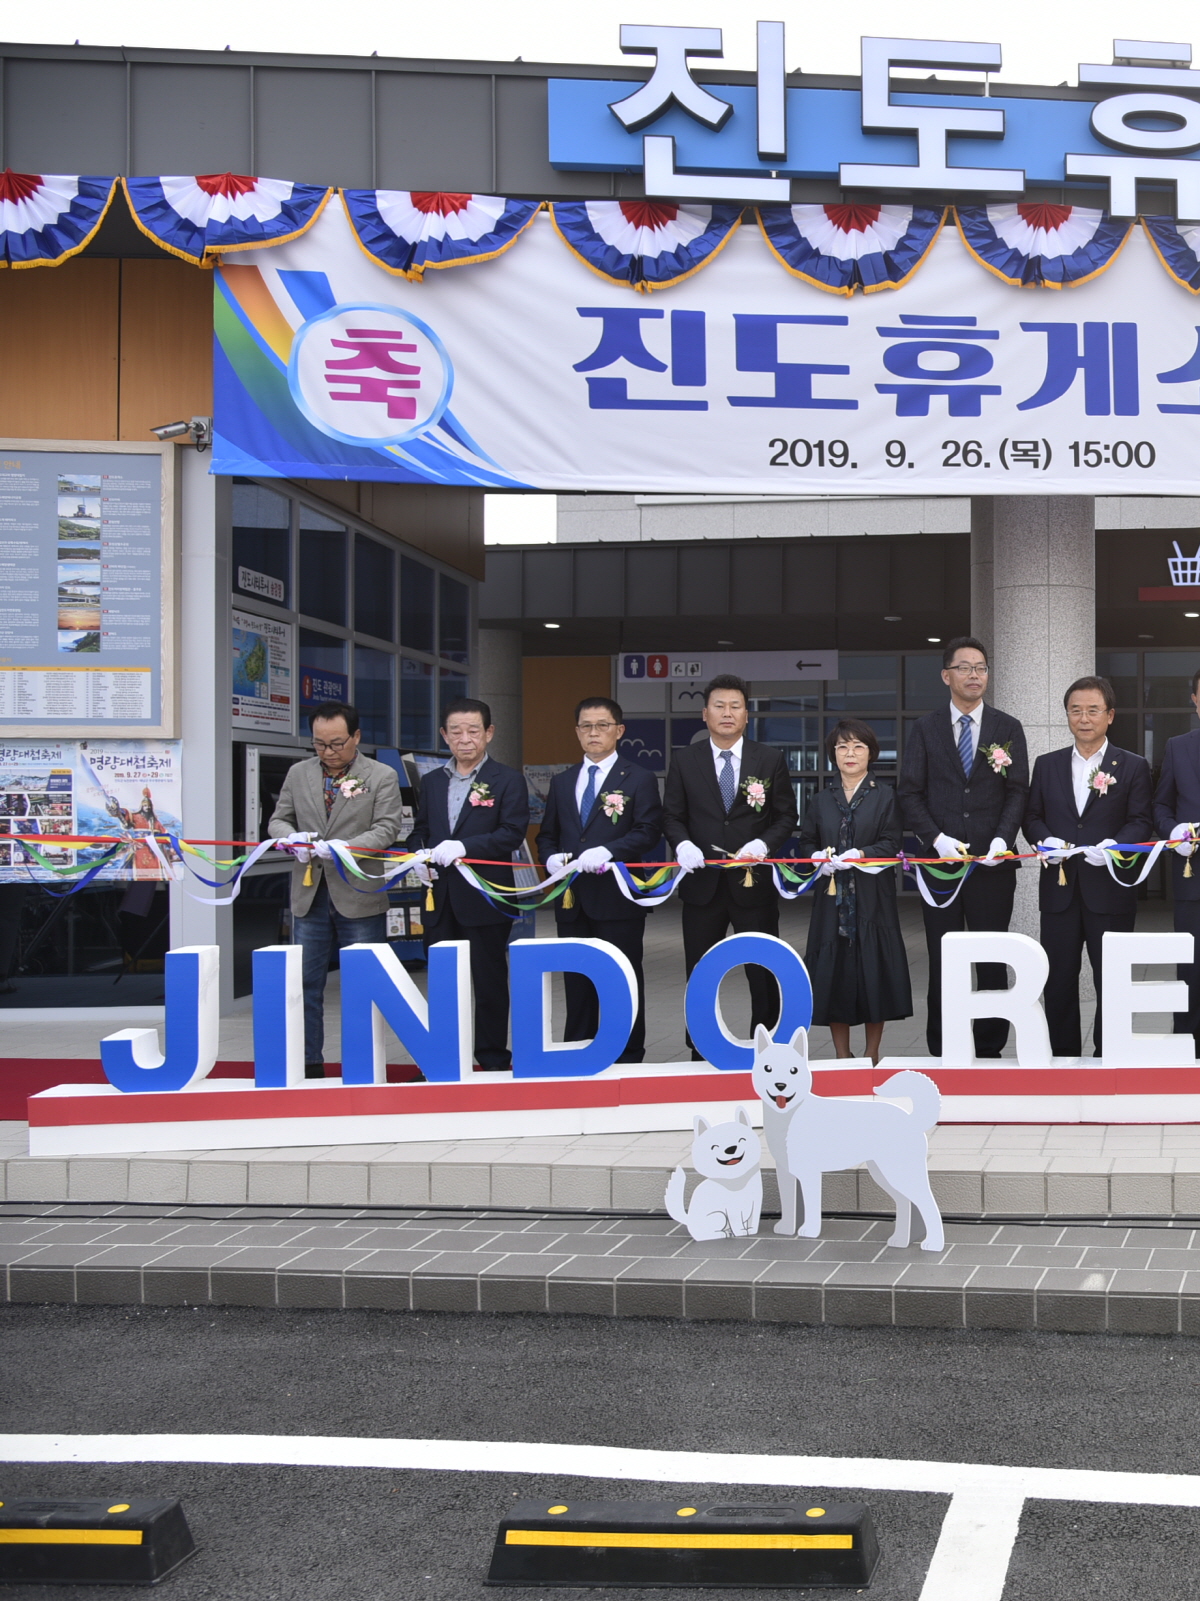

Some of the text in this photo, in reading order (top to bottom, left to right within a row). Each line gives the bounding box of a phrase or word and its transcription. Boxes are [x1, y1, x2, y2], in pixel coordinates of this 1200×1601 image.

[325, 329, 422, 420] 축
[768, 438, 858, 469] 2019.
[885, 439, 915, 469] 9.
[1068, 440, 1156, 469] 15:00
[90, 755, 172, 770] 명량대첩축제
[100, 932, 814, 1093] JINDO
